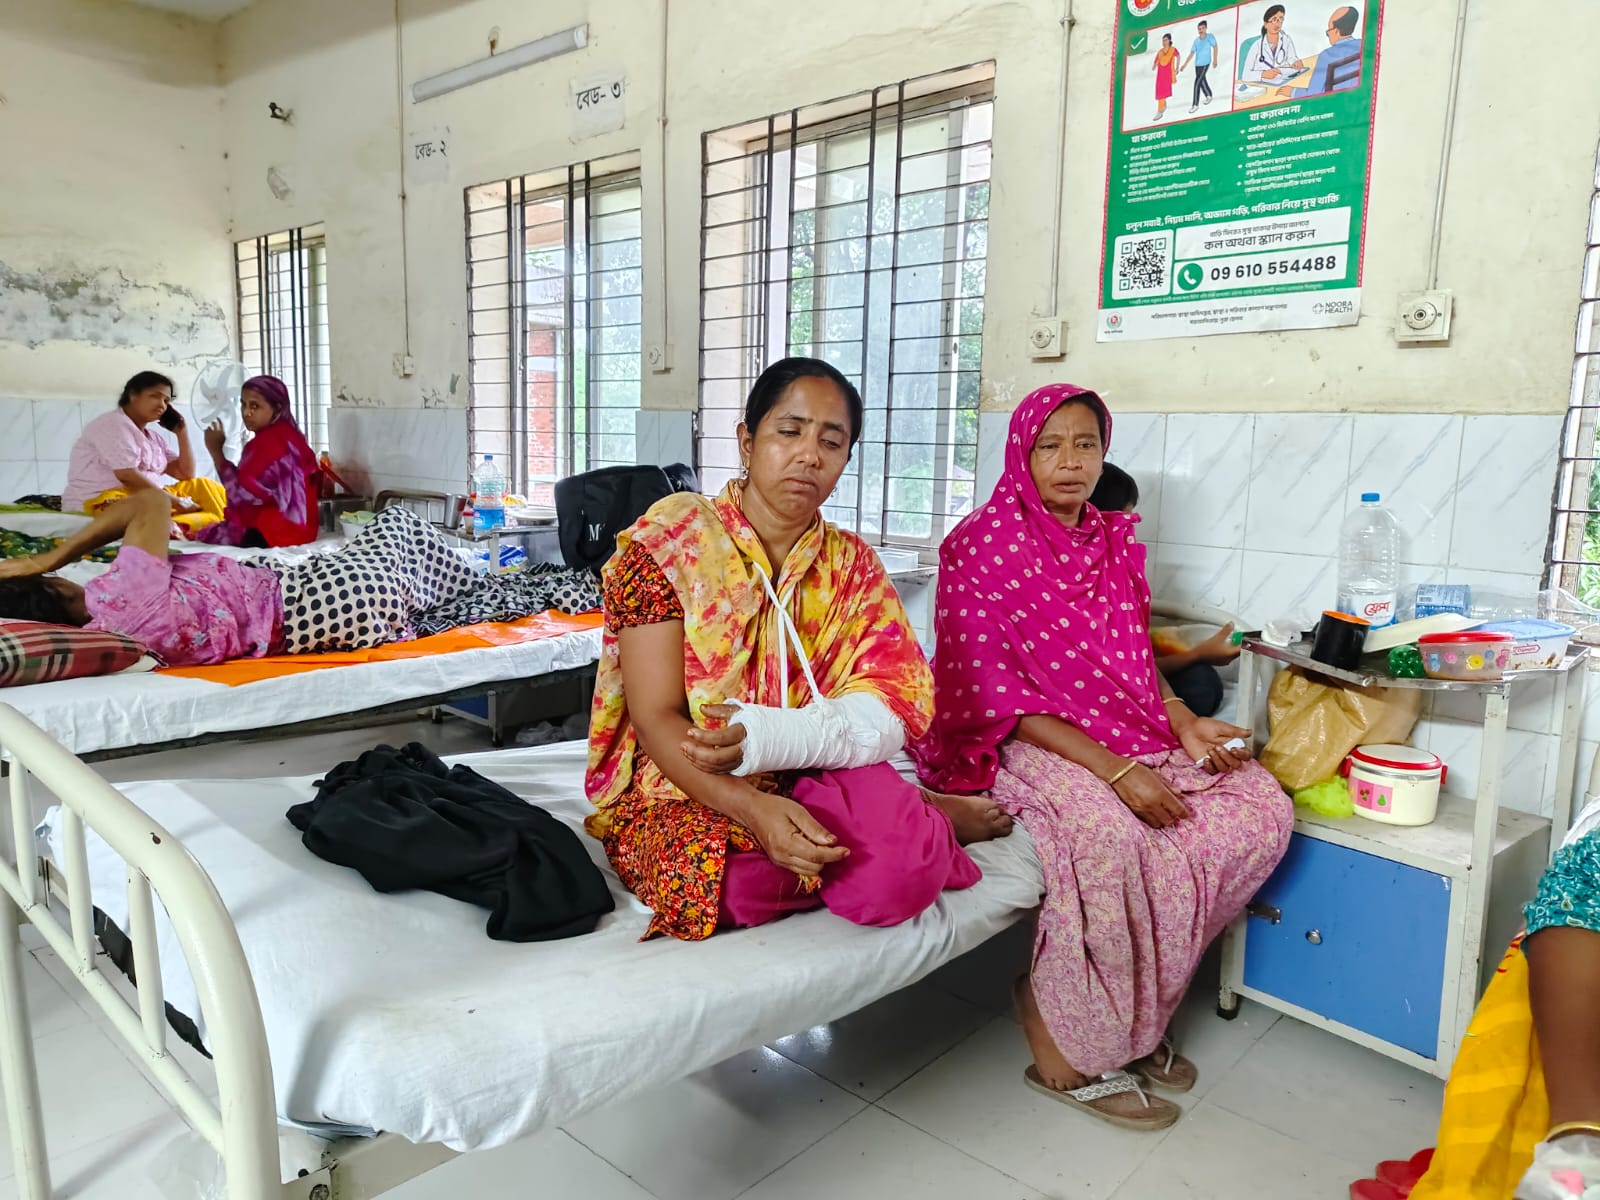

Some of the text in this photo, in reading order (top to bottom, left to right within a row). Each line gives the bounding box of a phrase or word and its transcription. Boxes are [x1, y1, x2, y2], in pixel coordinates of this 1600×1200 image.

[610, 84, 621, 99] ৩
[1249, 105, 1301, 121] যা করবেন না
[1140, 130, 1167, 142] করবেন
[440, 140, 447, 157] ২
[1251, 202, 1280, 213] পরিবার
[1317, 193, 1340, 204] থাকি
[1204, 240, 1223, 250] কল
[1225, 236, 1256, 247] অথবা
[1285, 229, 1316, 241] করুন
[1211, 255, 1336, 280] 09 610 554488
[1325, 300, 1352, 308] NOORA
[1325, 306, 1352, 314] HEALTH
